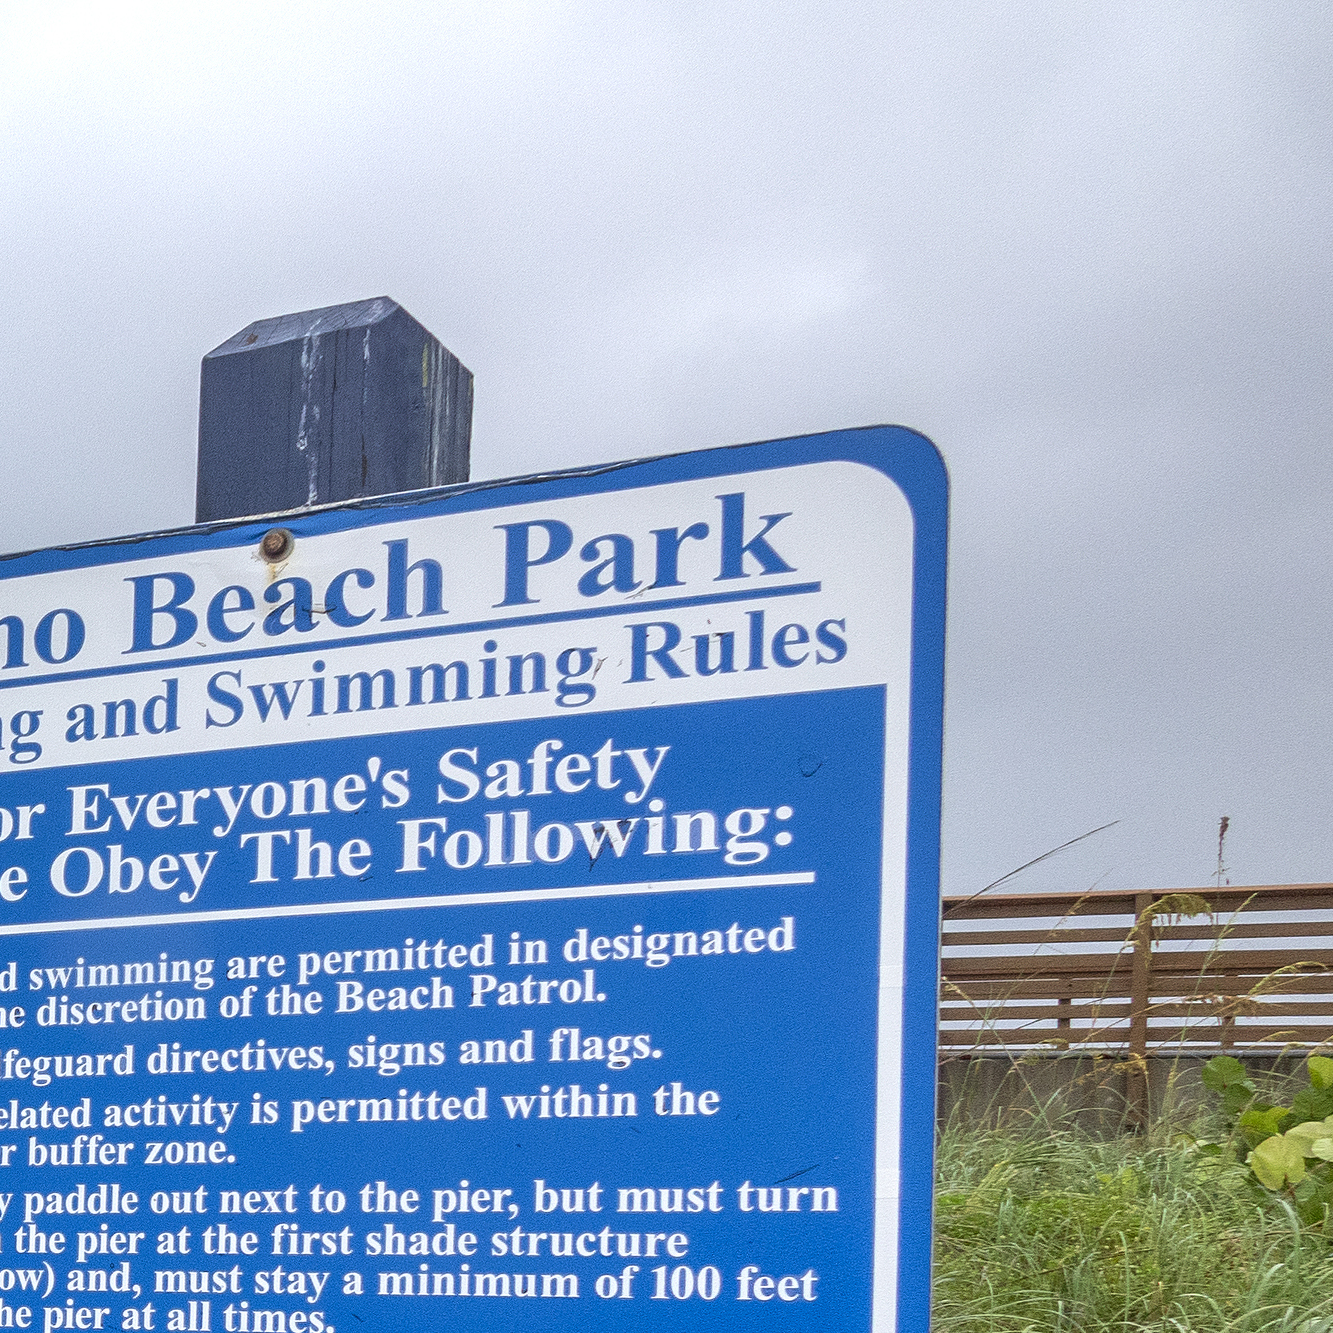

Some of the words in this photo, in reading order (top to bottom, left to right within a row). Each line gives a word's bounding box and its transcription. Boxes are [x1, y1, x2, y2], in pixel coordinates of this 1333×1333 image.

[121, 538, 449, 655] Beach
[491, 491, 797, 608] Park
[65, 677, 181, 743] and
[205, 639, 596, 729] Swimming
[622, 609, 847, 684] Rules
[64, 756, 410, 838] Everyone's
[437, 738, 671, 804] Safety
[50, 844, 219, 904] Obey
[240, 828, 372, 884] The
[395, 798, 794, 873] Following:
[29, 952, 215, 991] swimming
[227, 954, 286, 980] are
[297, 933, 495, 986] permitted
[508, 931, 548, 965] in
[563, 916, 795, 968] designated
[36, 990, 207, 1027] discretion
[219, 985, 259, 1018] of
[264, 984, 323, 1016] the
[334, 976, 455, 1013] Beach
[468, 969, 607, 1008] Patrol.
[146, 1039, 335, 1076] directives,
[348, 1034, 446, 1076] signs
[459, 1029, 535, 1064] and
[548, 1027, 663, 1070] flags.
[103, 1094, 239, 1134] activity
[250, 1092, 279, 1124] is
[290, 1087, 488, 1133] permitted
[501, 1083, 638, 1119] within
[652, 1082, 720, 1116] the
[28, 1134, 135, 1167] buffer
[144, 1141, 236, 1165] zone.
